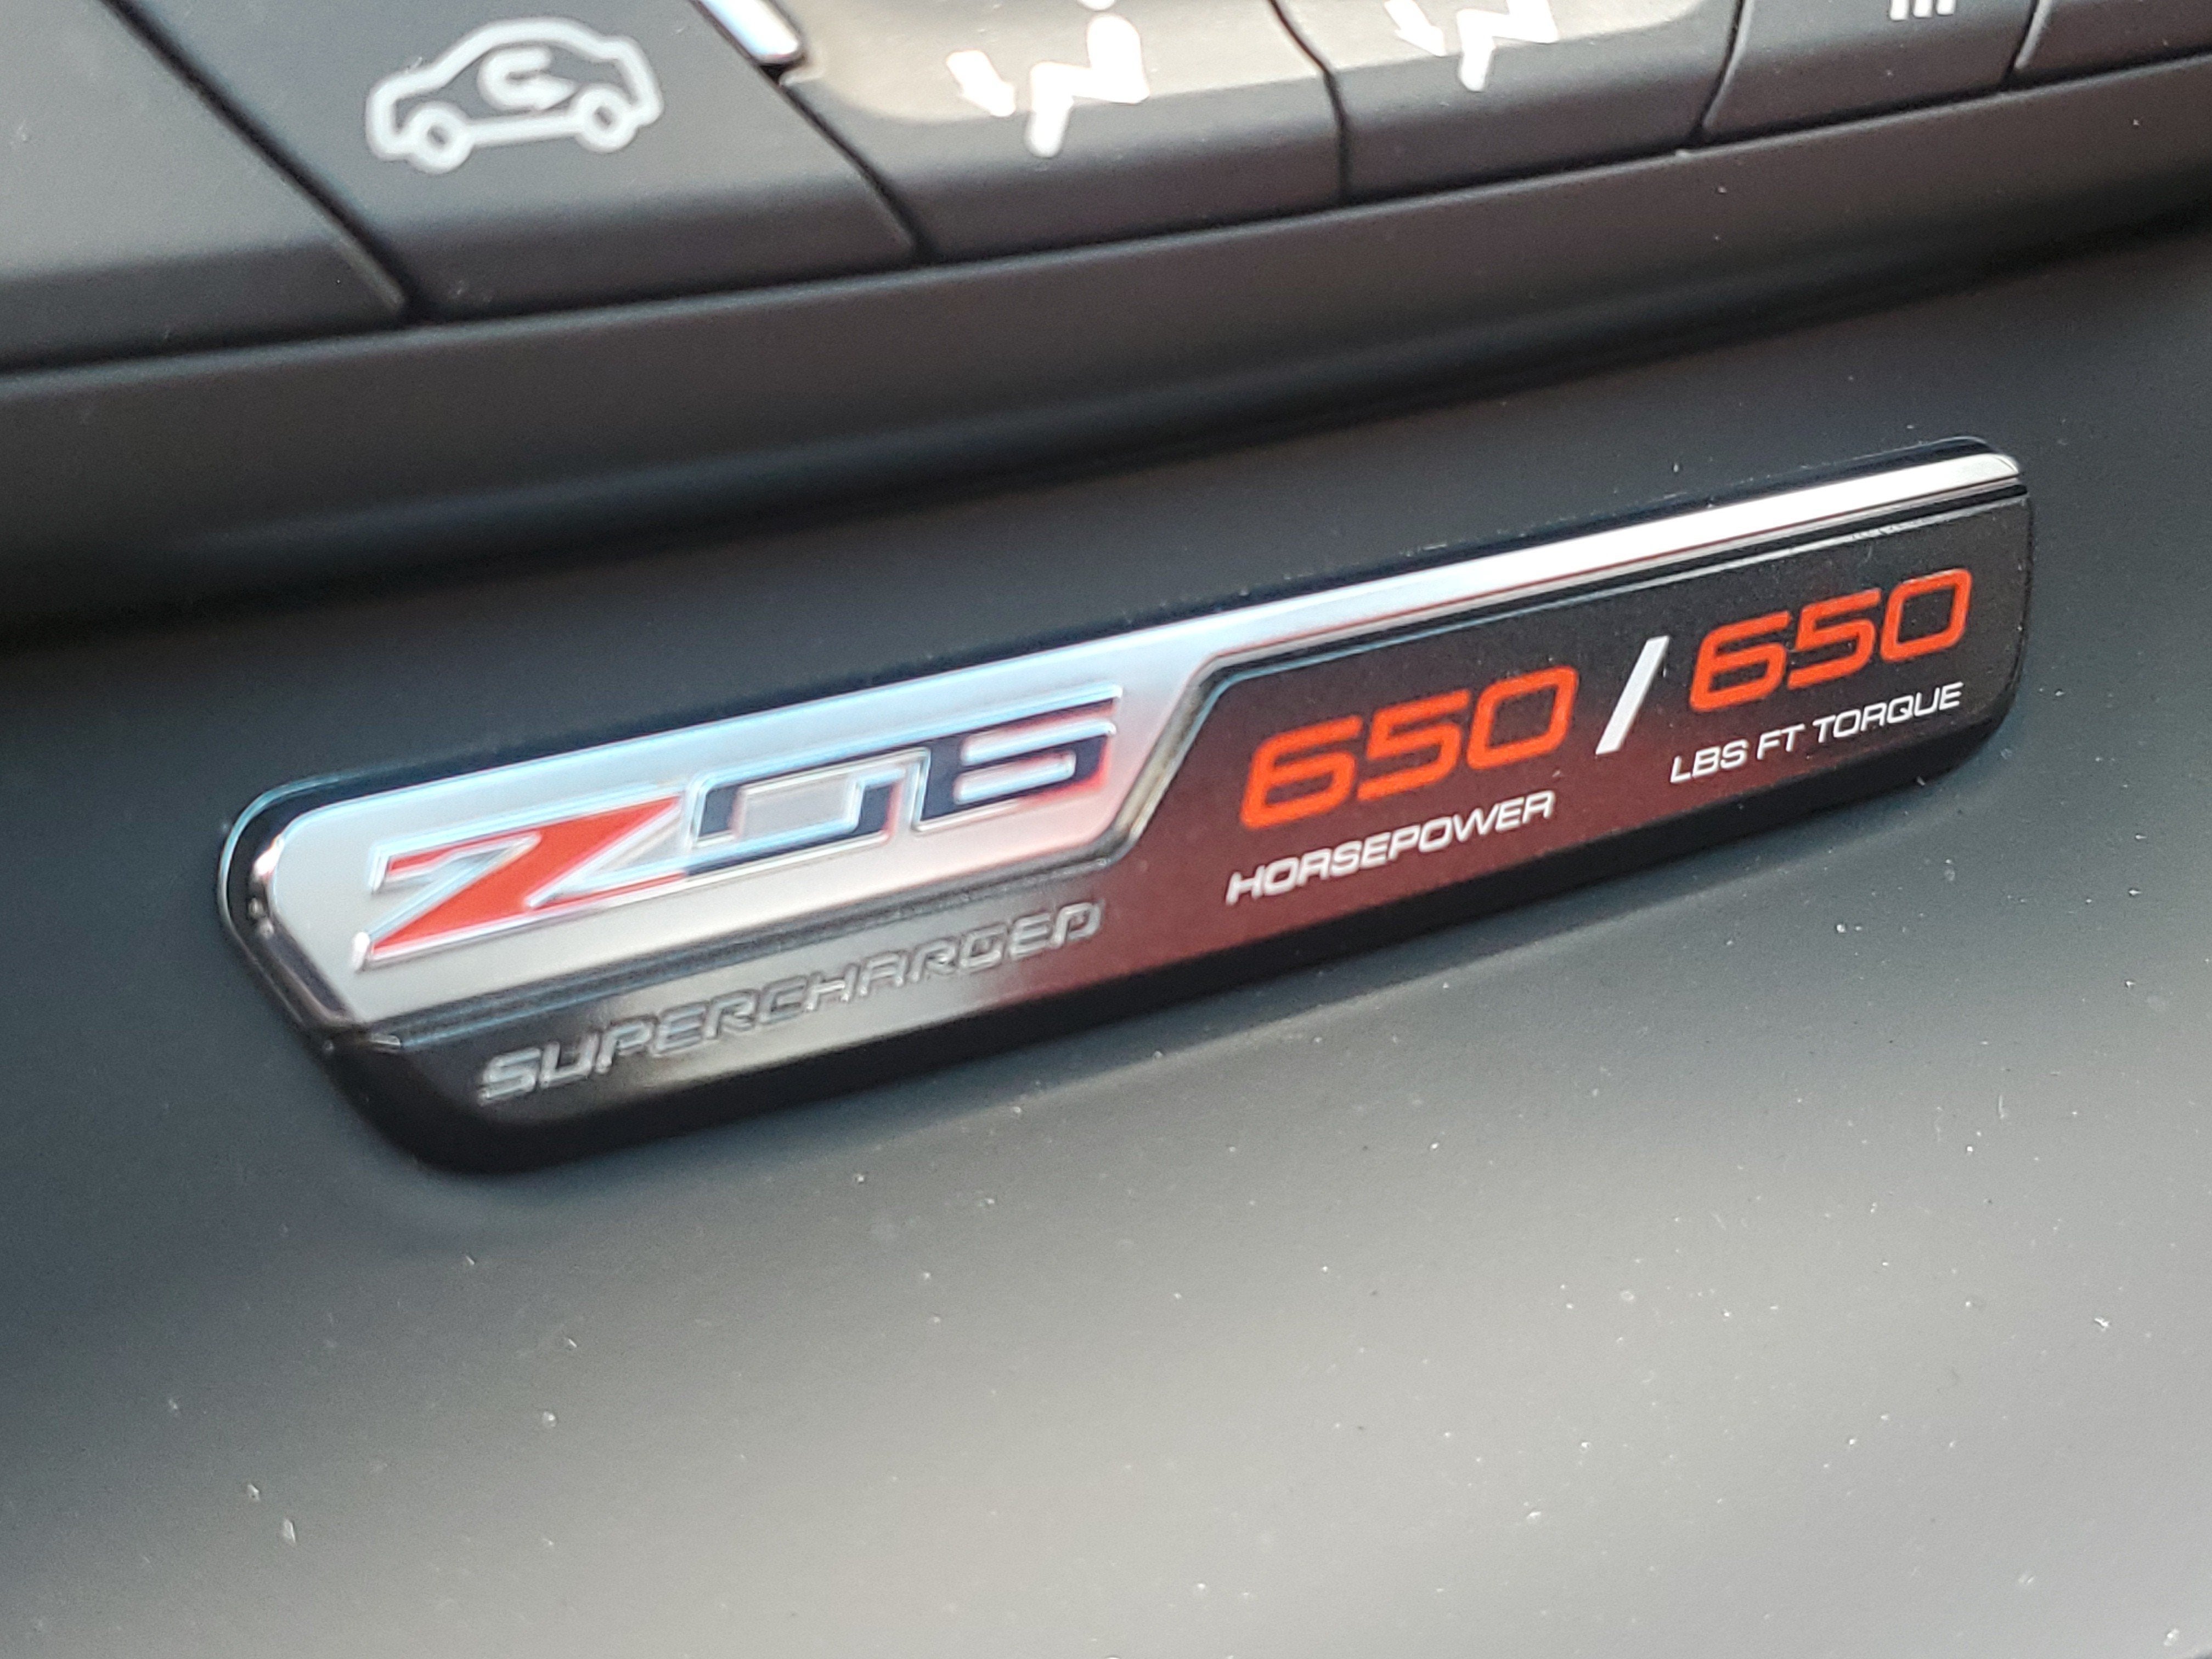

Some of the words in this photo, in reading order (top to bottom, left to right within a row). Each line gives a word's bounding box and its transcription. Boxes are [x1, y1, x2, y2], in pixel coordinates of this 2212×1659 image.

[1239, 665, 1579, 830] 650
[1688, 567, 1972, 713] 650
[1668, 738, 1749, 784] LBS
[1756, 722, 1807, 761] FT
[1813, 681, 1965, 744] TORQUE
[352, 684, 1122, 973] Z06
[1224, 790, 1556, 906] HORSEPOWER
[477, 900, 1105, 1105] SUPERCHARGED
